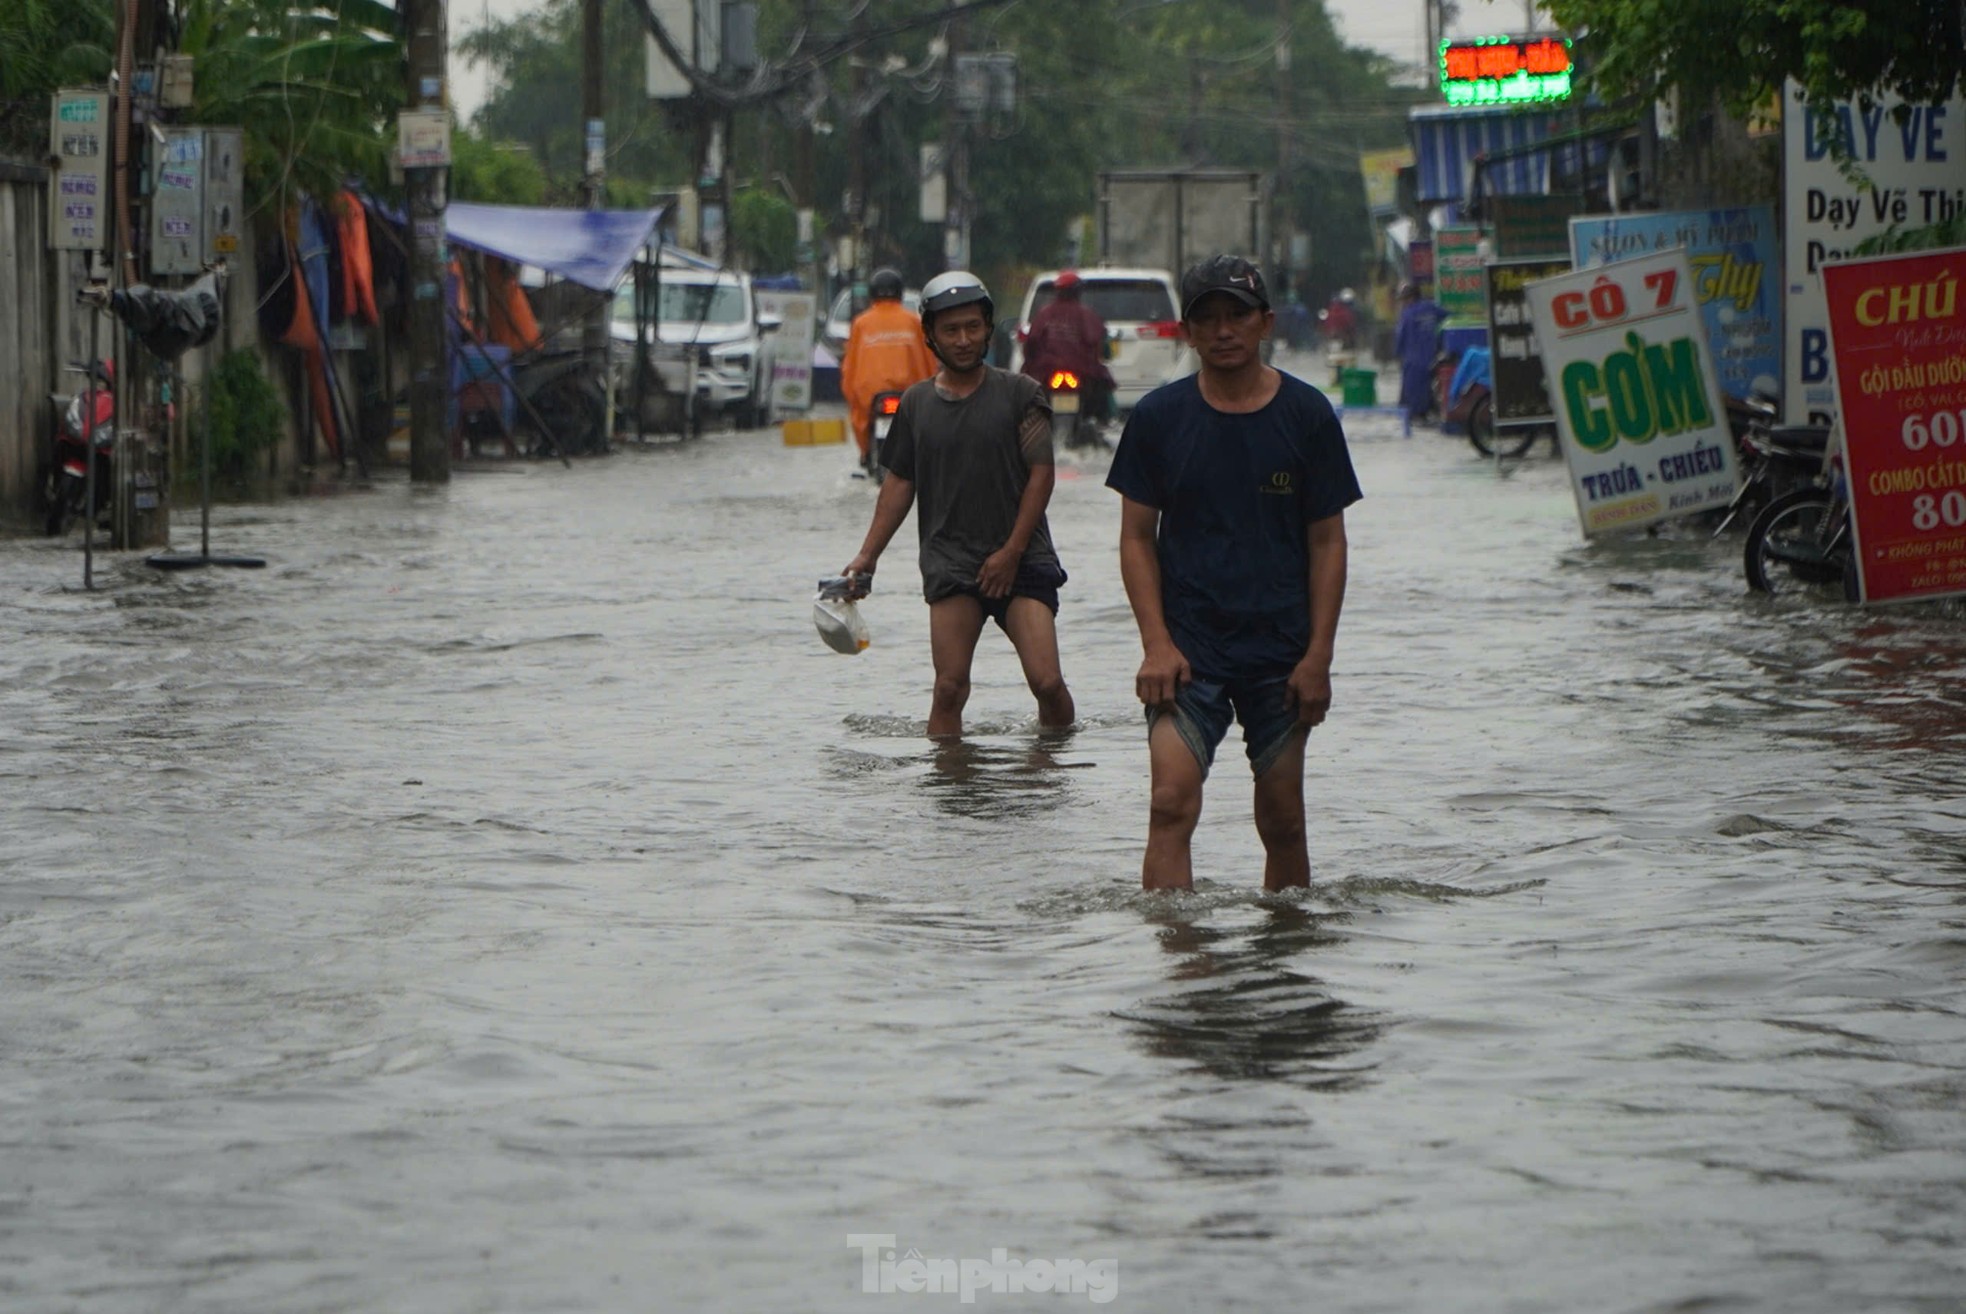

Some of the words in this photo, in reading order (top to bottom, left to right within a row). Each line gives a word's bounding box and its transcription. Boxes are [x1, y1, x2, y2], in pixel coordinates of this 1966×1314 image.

[1808, 188, 1861, 231] Dạy
[1872, 185, 1908, 224] Vẽ
[1919, 187, 1966, 224] Thi
[1551, 274, 1628, 329] CÔ
[1643, 268, 1678, 309] 7
[1855, 269, 1957, 327] CHÚ
[1562, 329, 1716, 454] CƠM
[1582, 460, 1643, 501] TRƯA
[1869, 466, 1926, 496] COMBO
